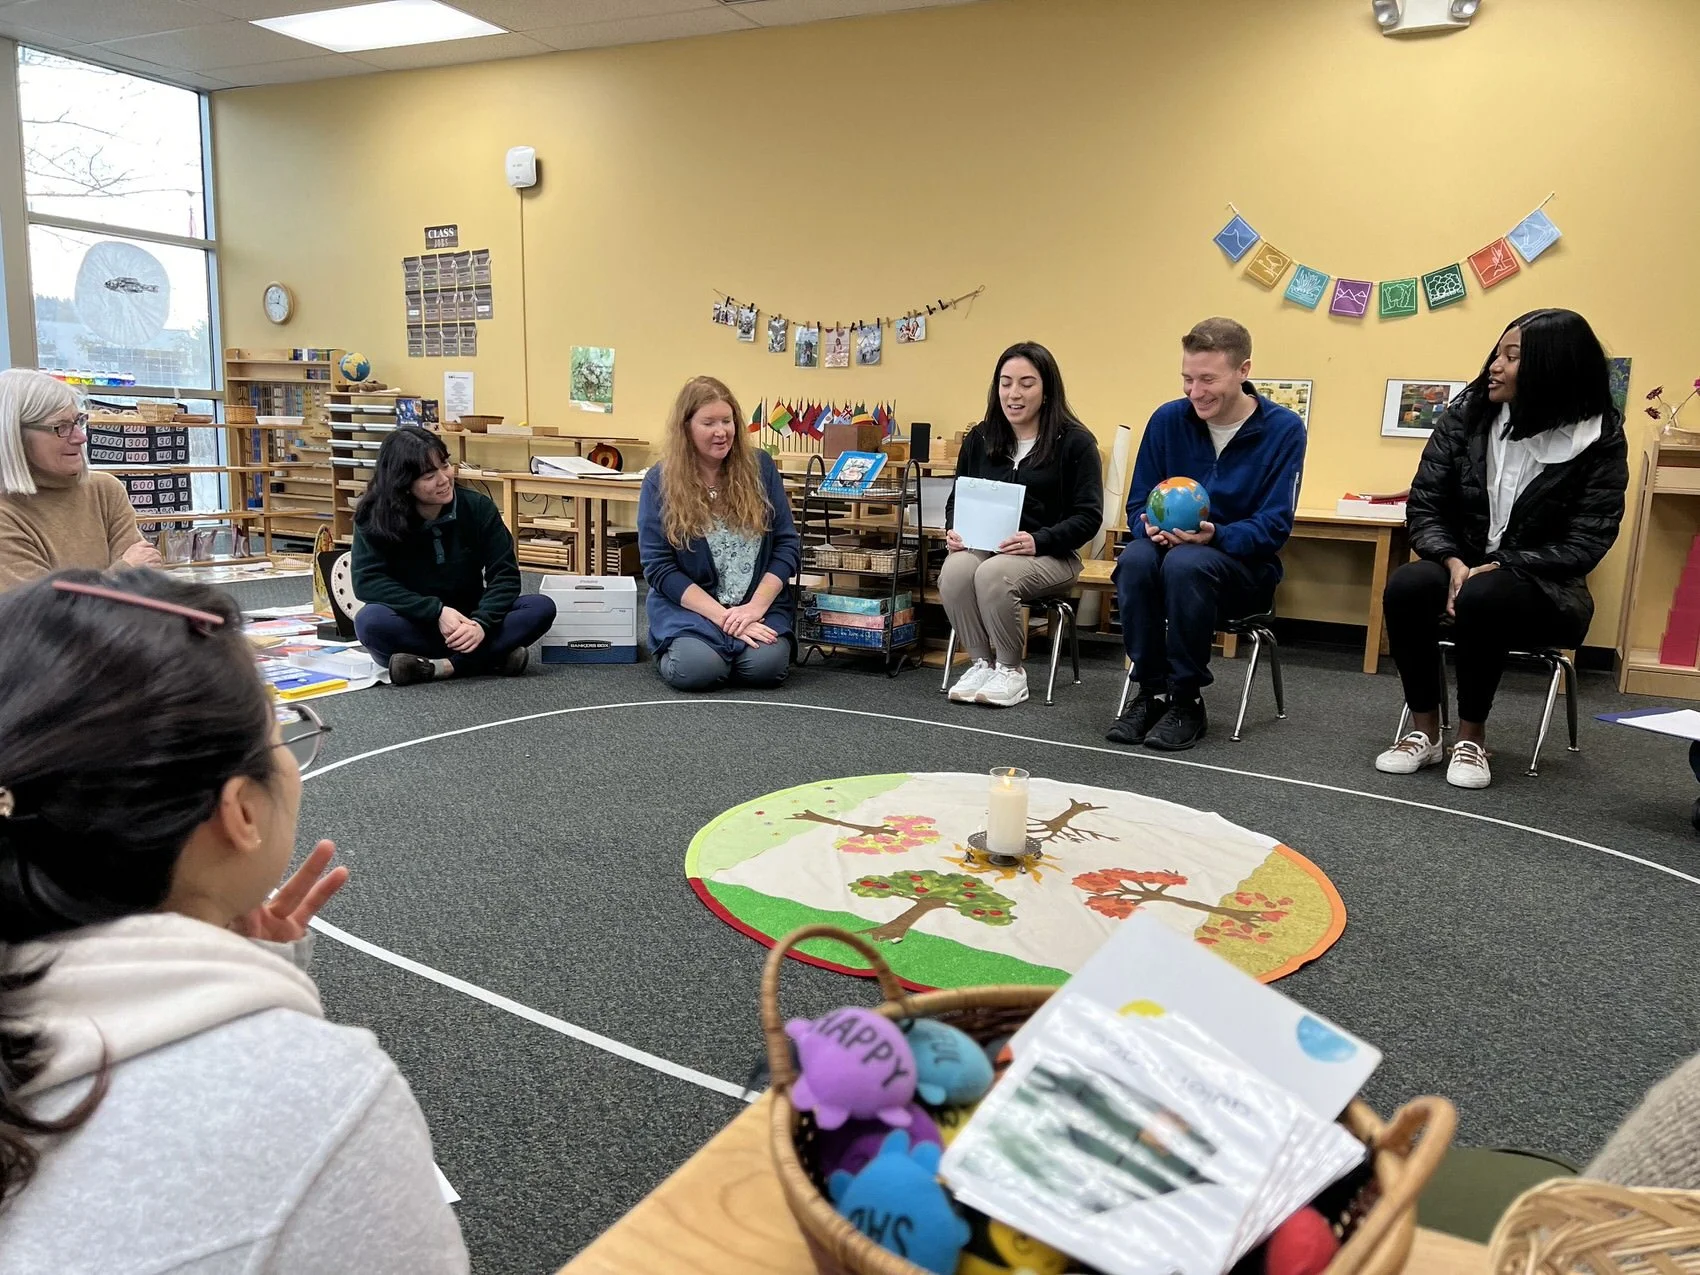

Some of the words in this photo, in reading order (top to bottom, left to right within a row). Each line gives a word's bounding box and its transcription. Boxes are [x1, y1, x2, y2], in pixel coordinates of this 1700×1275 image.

[428, 228, 454, 239] CLASS
[92, 435, 122, 446] 3000
[126, 438, 148, 447] 300
[158, 437, 171, 446] 30
[177, 436, 184, 445] 3
[92, 450, 122, 460] 4000
[127, 452, 148, 461] 400
[158, 450, 171, 459] 40
[132, 481, 153, 490] 600
[159, 479, 171, 488] 60
[180, 479, 186, 487] 6
[131, 495, 152, 503] 700
[161, 493, 174, 502] 70
[181, 492, 187, 500] 7
